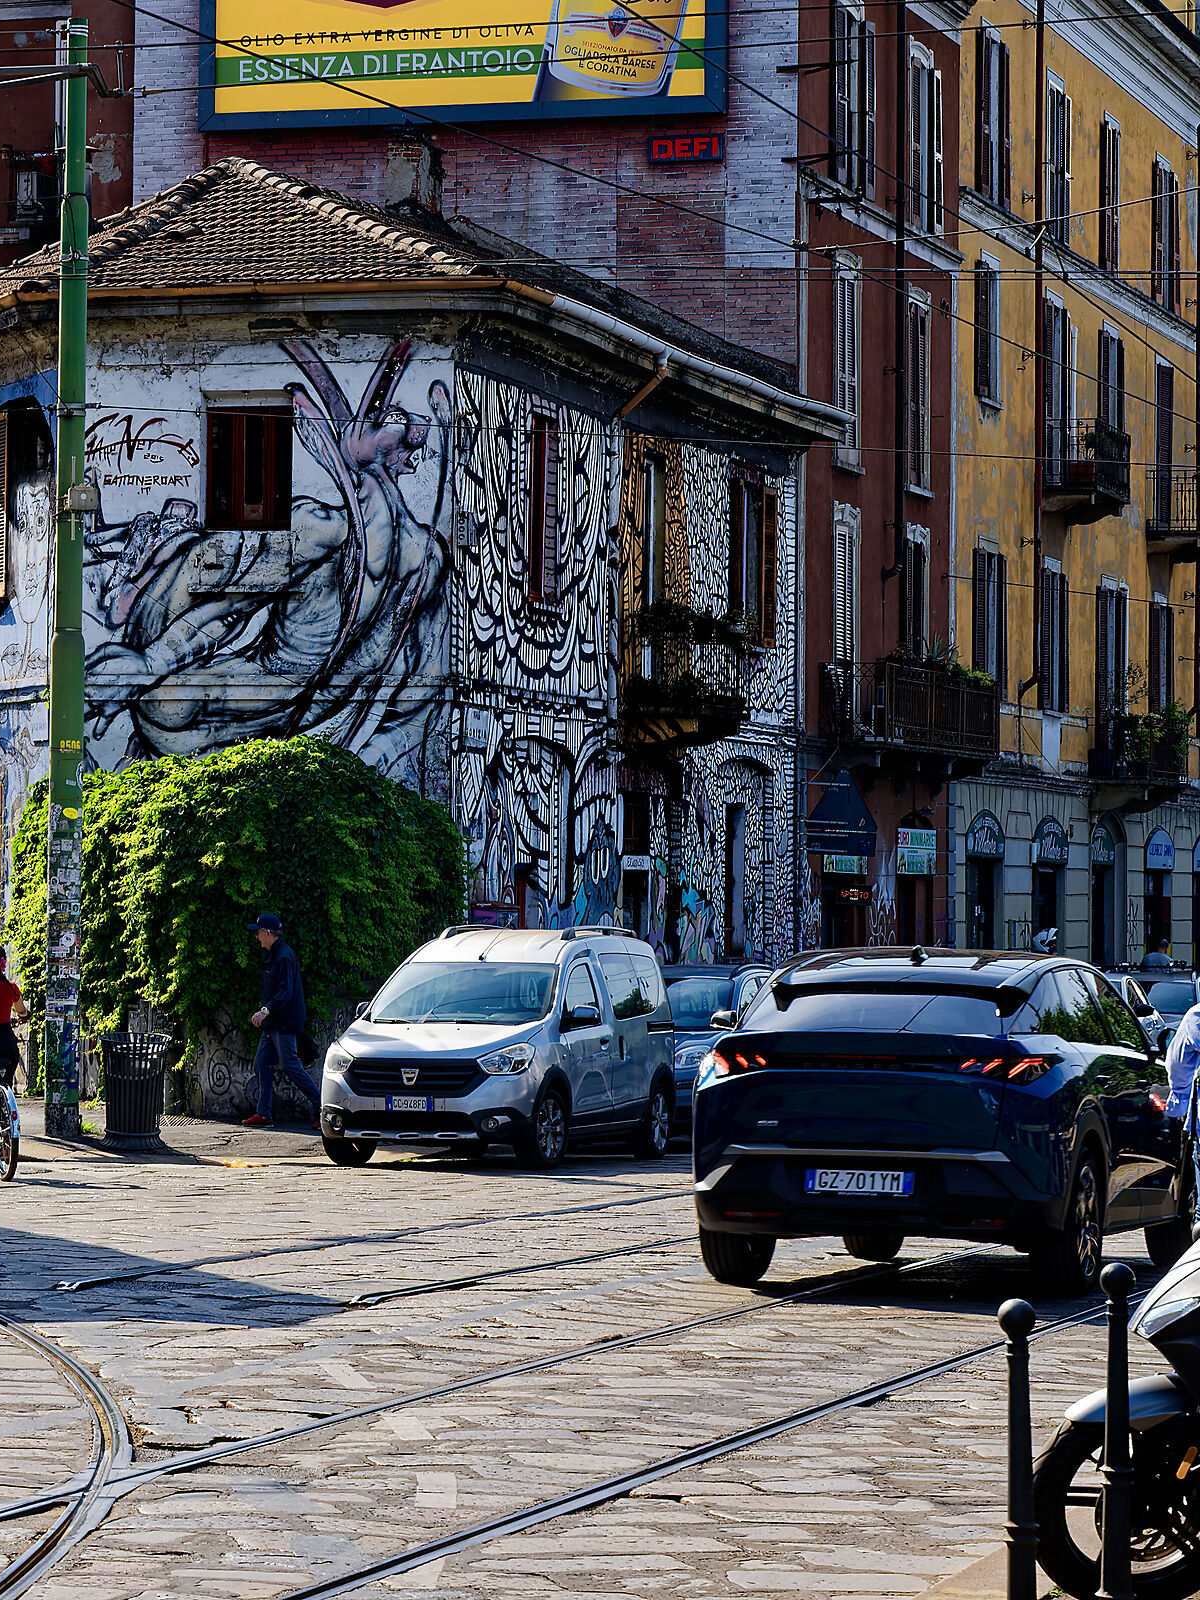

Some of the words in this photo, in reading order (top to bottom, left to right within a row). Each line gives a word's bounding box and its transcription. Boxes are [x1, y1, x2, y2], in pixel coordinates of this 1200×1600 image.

[240, 33, 284, 47] OLIO
[295, 31, 351, 45] EXTRA
[362, 28, 442, 42] VERGINE
[452, 27, 469, 39] DI
[479, 24, 534, 38] OLIVA
[239, 55, 355, 82] ESSENZA
[363, 53, 388, 76] DI
[396, 48, 535, 76] FRANTOIO
[564, 44, 620, 64] OGLIAROLA
[620, 56, 657, 70] BARESE
[578, 60, 584, 69] E
[586, 61, 638, 78] CORATINA
[652, 136, 719, 159] DEFI
